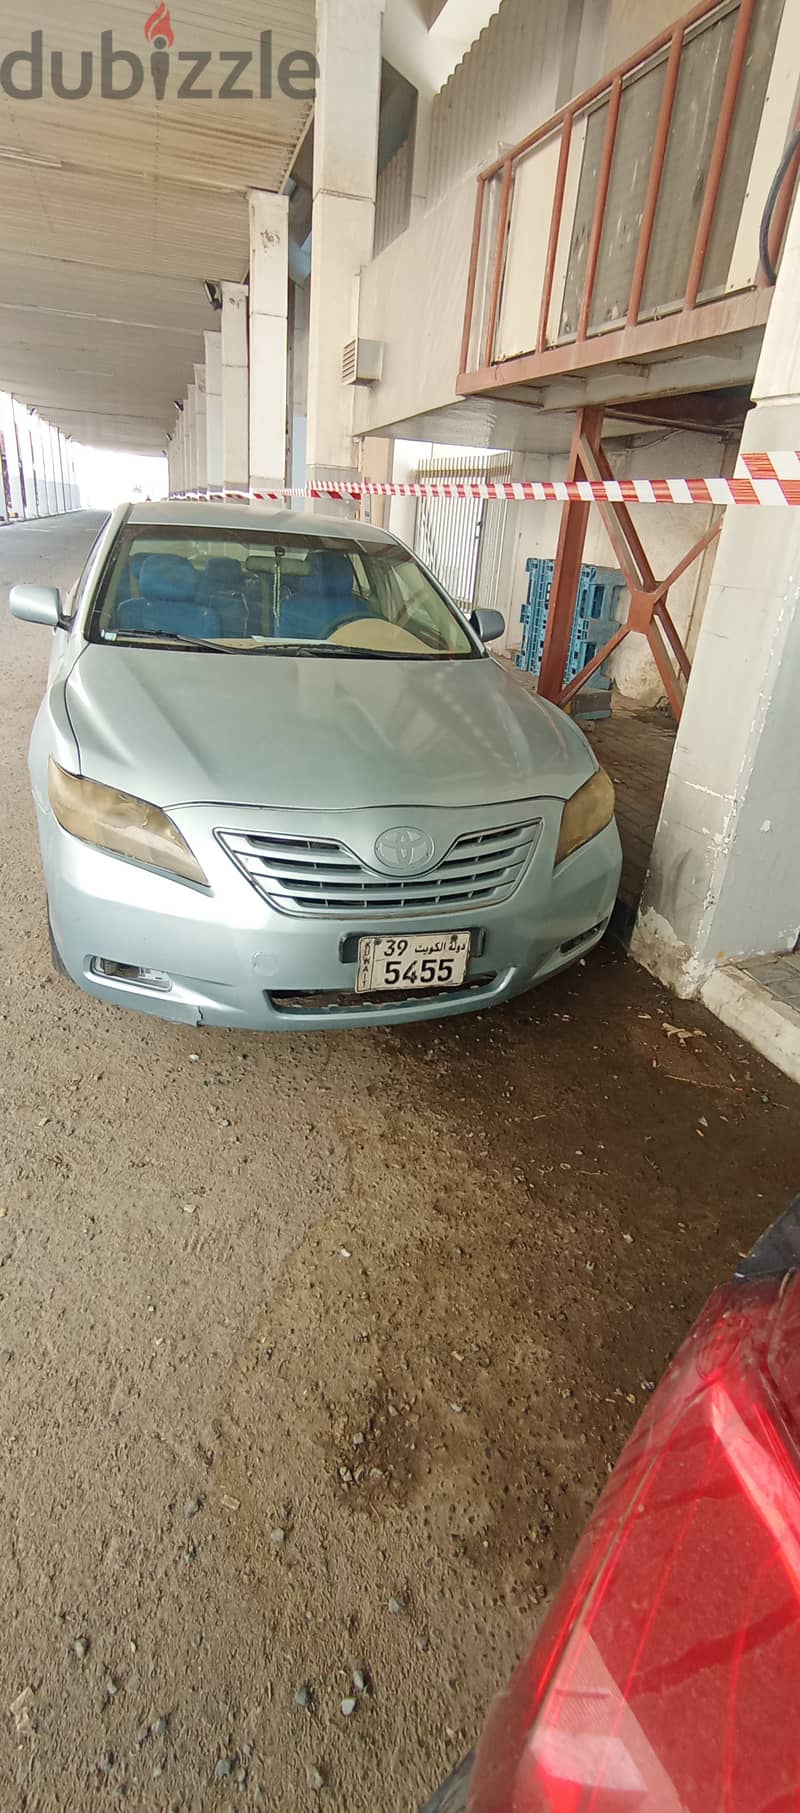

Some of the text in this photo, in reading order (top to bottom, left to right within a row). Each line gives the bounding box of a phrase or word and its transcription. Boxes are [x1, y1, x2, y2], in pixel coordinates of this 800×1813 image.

[384, 939, 408, 957] 39
[414, 942, 447, 955] الكويت
[362, 941, 371, 987] KUWAIT
[384, 958, 455, 984] 5455
